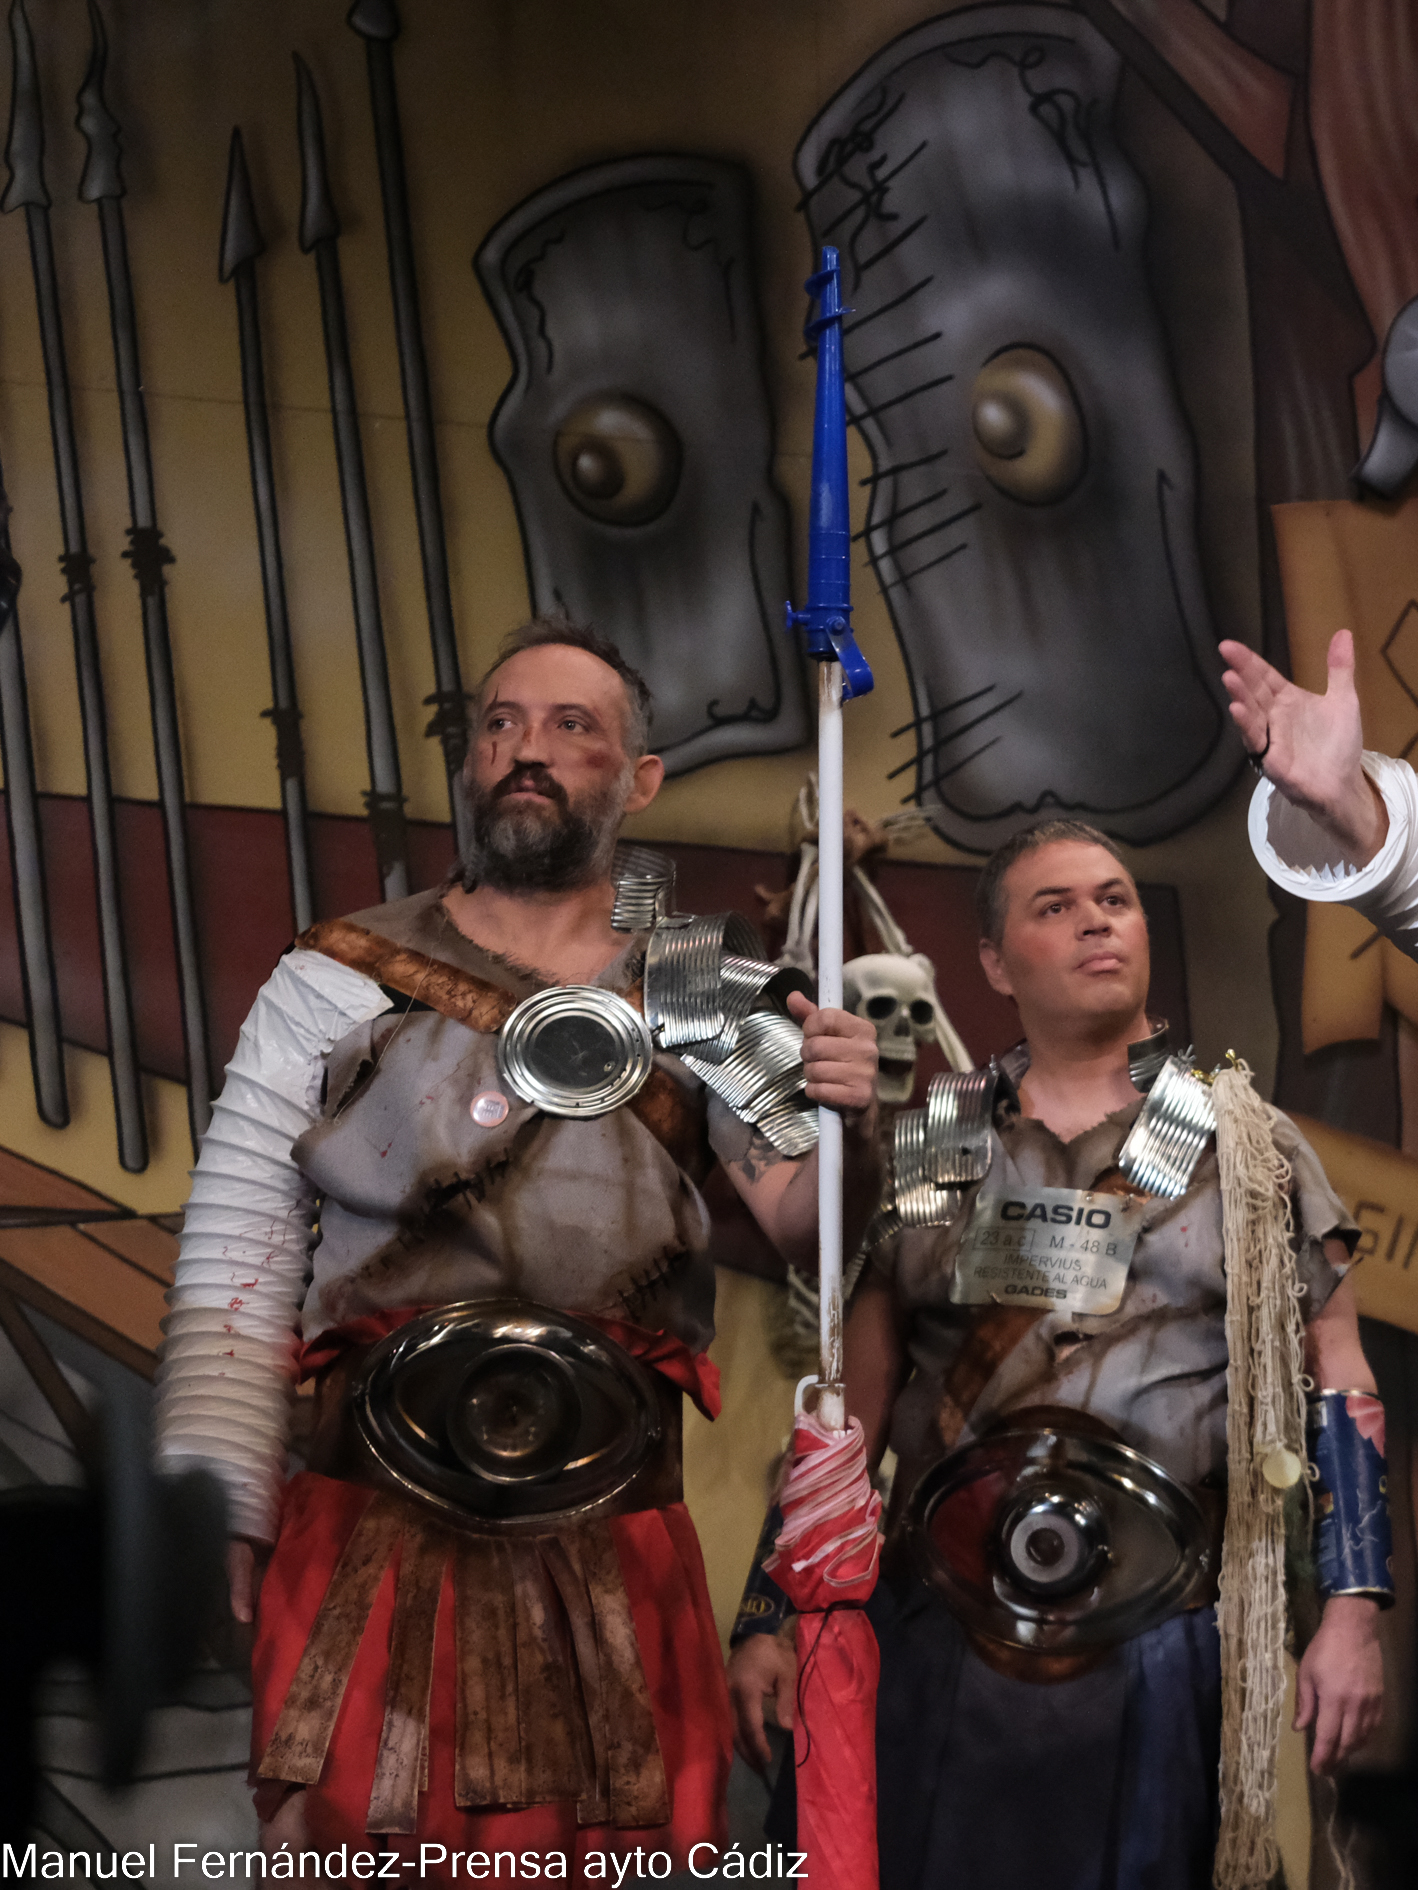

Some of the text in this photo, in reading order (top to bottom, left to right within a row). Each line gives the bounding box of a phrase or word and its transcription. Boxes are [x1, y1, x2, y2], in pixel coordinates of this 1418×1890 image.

[1000, 1201, 1112, 1229] CASIO
[981, 1230, 999, 1246] 23
[1003, 1253, 1082, 1271] IMPERVIUS
[973, 1265, 1108, 1291] RESISTENTE AL AGUA
[1004, 1283, 1068, 1300] GADES
